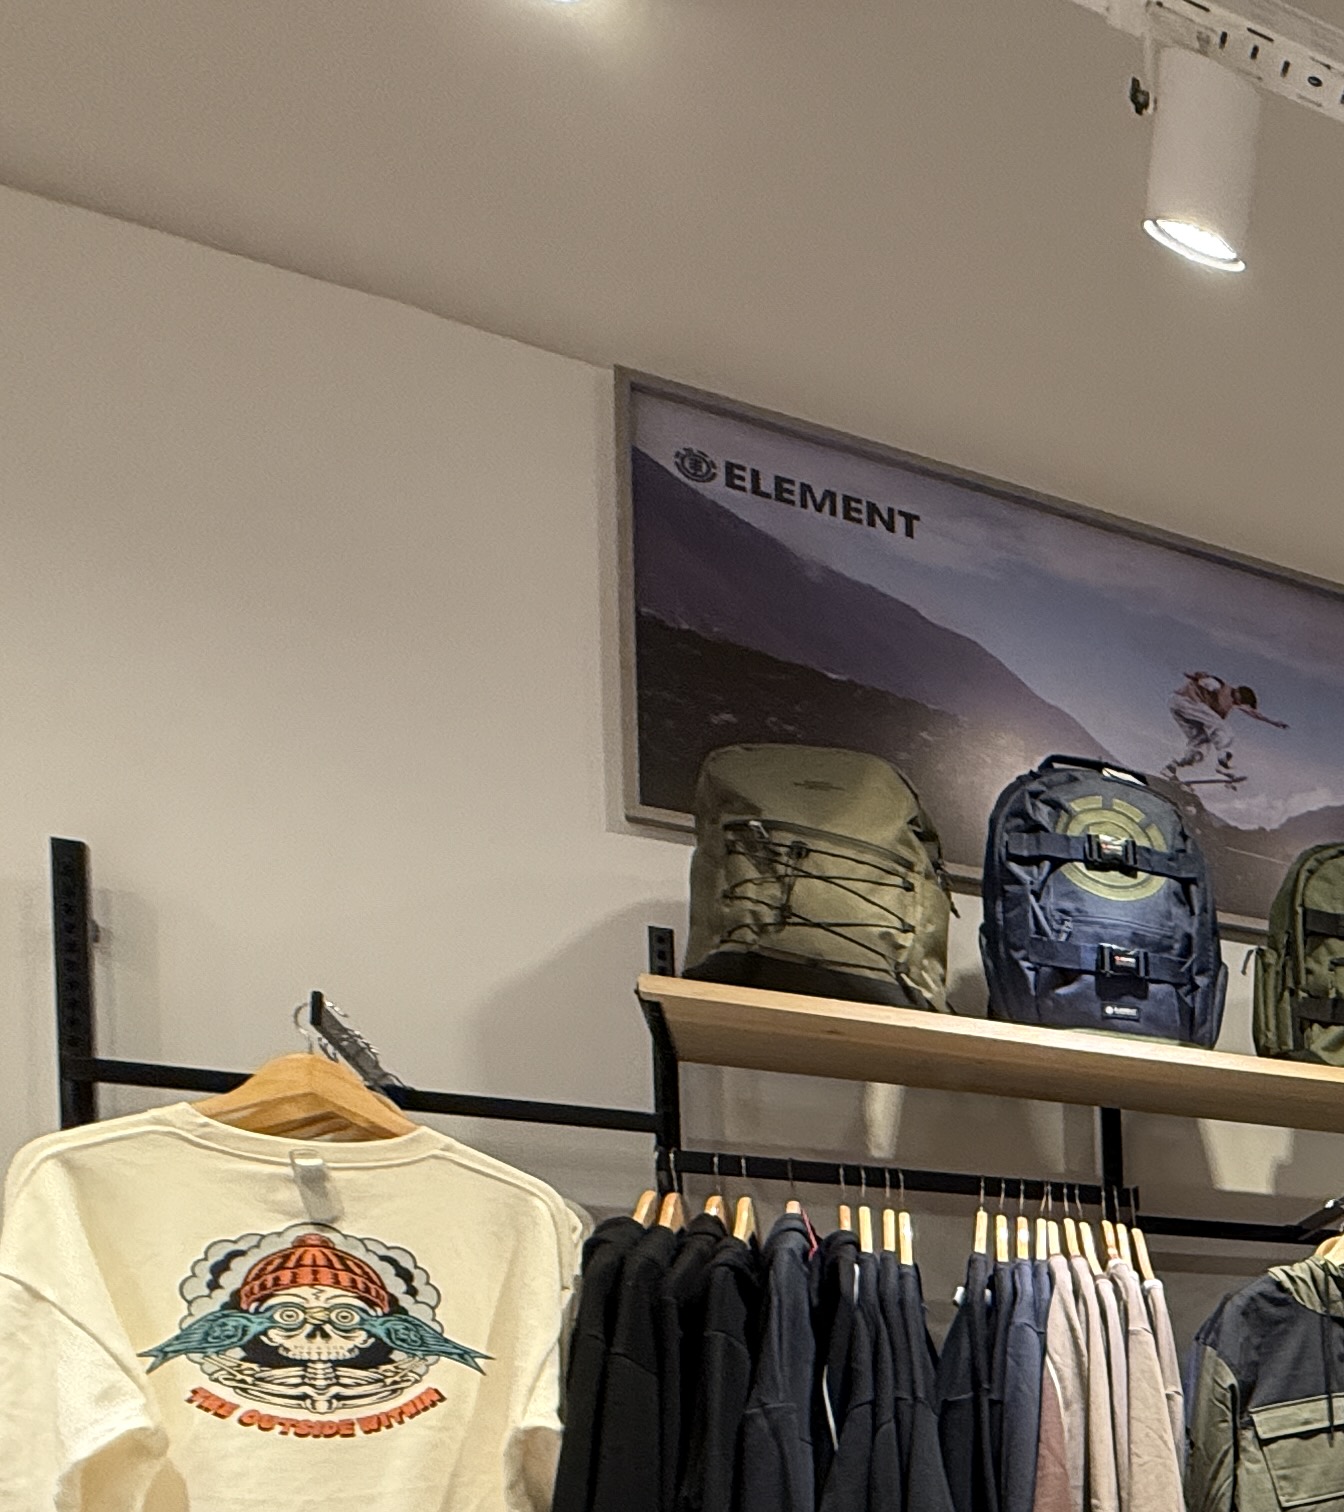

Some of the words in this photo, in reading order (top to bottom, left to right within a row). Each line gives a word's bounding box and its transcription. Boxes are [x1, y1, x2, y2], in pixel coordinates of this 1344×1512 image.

[724, 460, 921, 540] ELEMENT
[184, 1386, 240, 1419] THE
[238, 1409, 356, 1438] OUTSIDE
[355, 1386, 447, 1434] WITHIN
